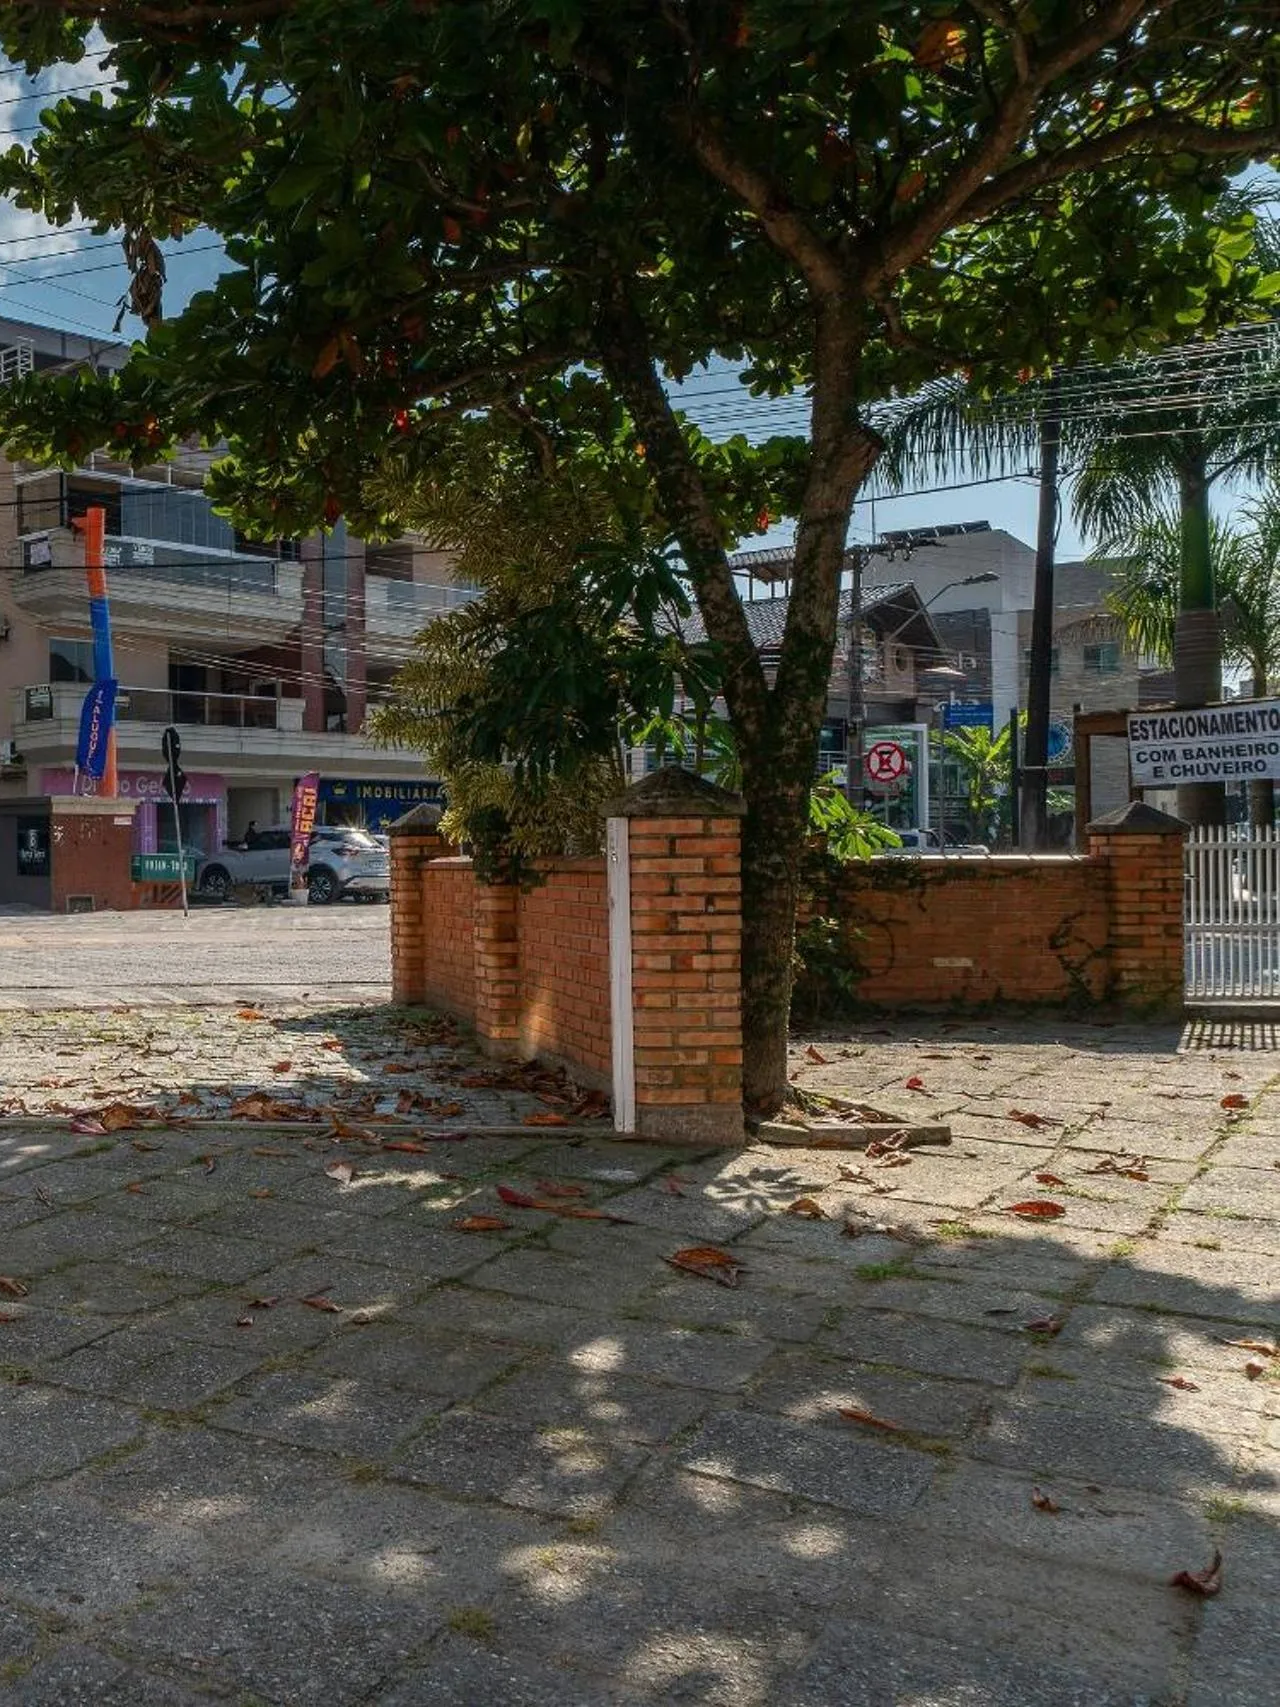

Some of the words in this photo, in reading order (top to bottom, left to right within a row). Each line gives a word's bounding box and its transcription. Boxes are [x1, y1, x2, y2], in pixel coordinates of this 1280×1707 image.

[1129, 708, 1280, 741] ESTACIONAMENTO
[1136, 749, 1176, 764] COM
[1183, 742, 1279, 761] BANHEIRO
[1153, 766, 1164, 778] E
[1170, 759, 1267, 777] CHUVEIRO
